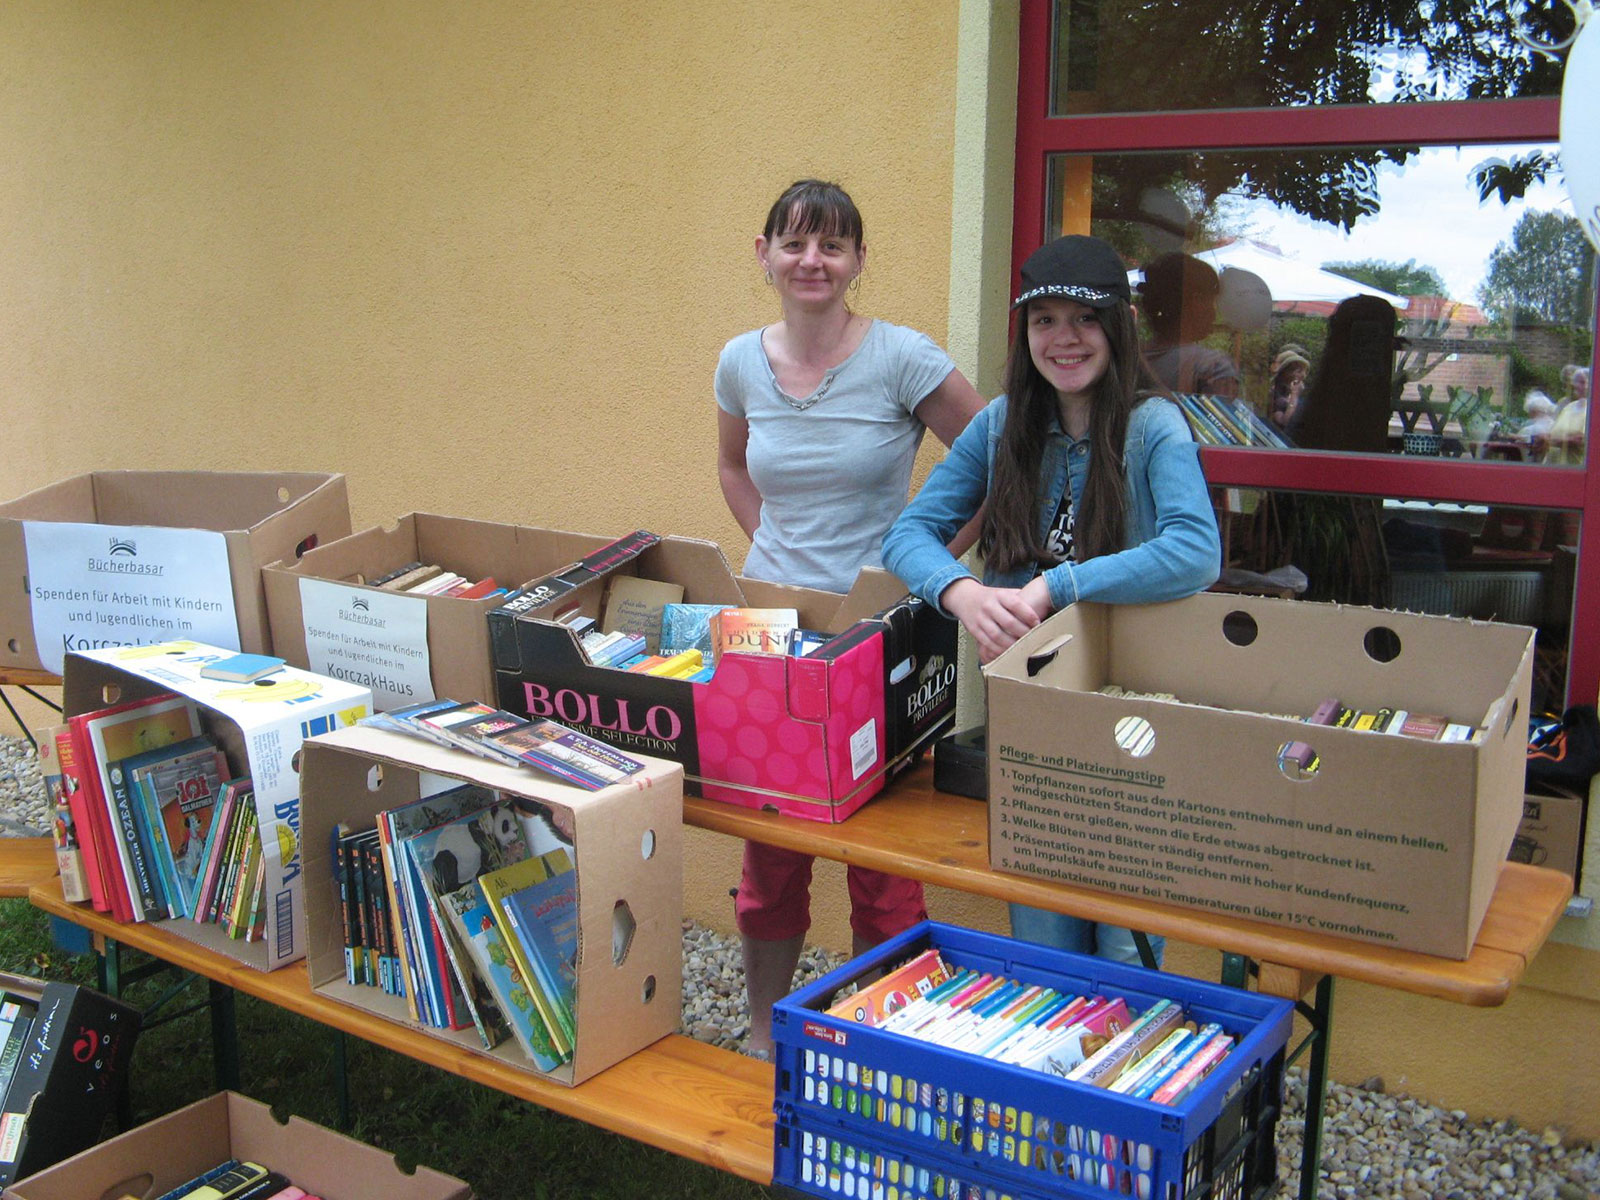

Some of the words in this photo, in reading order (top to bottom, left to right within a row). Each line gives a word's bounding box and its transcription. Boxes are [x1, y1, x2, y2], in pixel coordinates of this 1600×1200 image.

[88, 558, 164, 576] Bücherbasar
[35, 587, 89, 602] Spenden
[92, 589, 108, 603] für
[112, 592, 148, 606] Arbeit
[152, 596, 171, 608] mit
[174, 597, 223, 612] Kindern
[503, 585, 550, 610] BOLLO
[513, 590, 558, 612] PRIVILEGE
[68, 610, 92, 623] und
[96, 611, 174, 630] Jugendlichen
[177, 618, 192, 631] im
[338, 609, 386, 629] Bücherbasar
[308, 627, 339, 641] Spenden
[341, 633, 351, 644] für
[354, 636, 377, 648] Arbeit
[378, 643, 391, 652] mit
[393, 643, 423, 659] Kindern
[328, 647, 343, 657] und
[345, 649, 393, 668] Jugendlichen
[395, 661, 405, 671] im
[327, 662, 414, 696] KorczakHaus
[907, 663, 955, 717] BOLLO
[522, 681, 682, 741] BOLLO
[913, 687, 949, 724] PRIVILEGE
[602, 729, 677, 752] SELECTION
[1000, 745, 1039, 762] Pflege-
[1041, 756, 1063, 767] und
[1066, 759, 1166, 784] Platzierungstipp
[176, 775, 210, 803] 101
[1013, 783, 1111, 810] windgeschützten
[1113, 802, 1167, 820] Standort
[1170, 811, 1237, 832] platzieren.
[115, 788, 136, 841] OZEAN
[1000, 768, 1010, 779] 1.
[1012, 769, 1086, 793] Topfpflanzen
[1089, 784, 1125, 800] sofort
[1127, 793, 1148, 803] aus
[1151, 796, 1174, 808] den
[1178, 801, 1226, 817] Kartons
[1229, 810, 1303, 829] entnehmen
[1307, 822, 1333, 834] und
[1336, 826, 1352, 836] an
[1356, 829, 1398, 844] einem
[1401, 834, 1448, 852] hellen,
[1000, 797, 1010, 808] 2.
[1012, 799, 1061, 817] Pflanzen
[1063, 811, 1086, 823] erst
[1089, 816, 1132, 832] gießen,
[1135, 823, 1168, 836] wenn
[1170, 828, 1190, 841] die
[1193, 832, 1222, 846] Erde
[1224, 839, 1261, 853] etwas
[1264, 845, 1352, 868] abgetrocknet
[1355, 860, 1376, 872] ist.
[1001, 814, 1010, 824] 3.
[1012, 815, 1047, 831] Welke
[1049, 822, 1086, 839] Blüten
[1089, 831, 1112, 843] und
[1115, 835, 1156, 852] Blätter
[1158, 844, 1205, 861] ständig
[1207, 852, 1273, 872] entfernen.
[1001, 830, 1011, 840] 4.
[1013, 833, 1085, 855] Präsentation
[1087, 849, 1105, 859] am
[1108, 850, 1148, 867] besten
[1151, 858, 1163, 869] in
[1166, 862, 1227, 880] Bereichen
[1230, 874, 1251, 886] mit
[1254, 877, 1293, 892] hoher
[1295, 884, 1410, 915] Kundenfrequenz,
[1014, 846, 1031, 856] um
[1034, 848, 1105, 871] Impulskäufe
[1107, 864, 1178, 884] auszulösen.
[1002, 858, 1012, 869] 5.
[1014, 860, 1117, 890] Außenplatzierung
[1119, 883, 1140, 894] nur
[1142, 886, 1161, 897] bei
[1164, 889, 1250, 914] Temperaturen
[1254, 906, 1283, 920] über
[1287, 912, 1317, 926] 15°C
[1319, 920, 1398, 941] vornehmen.
